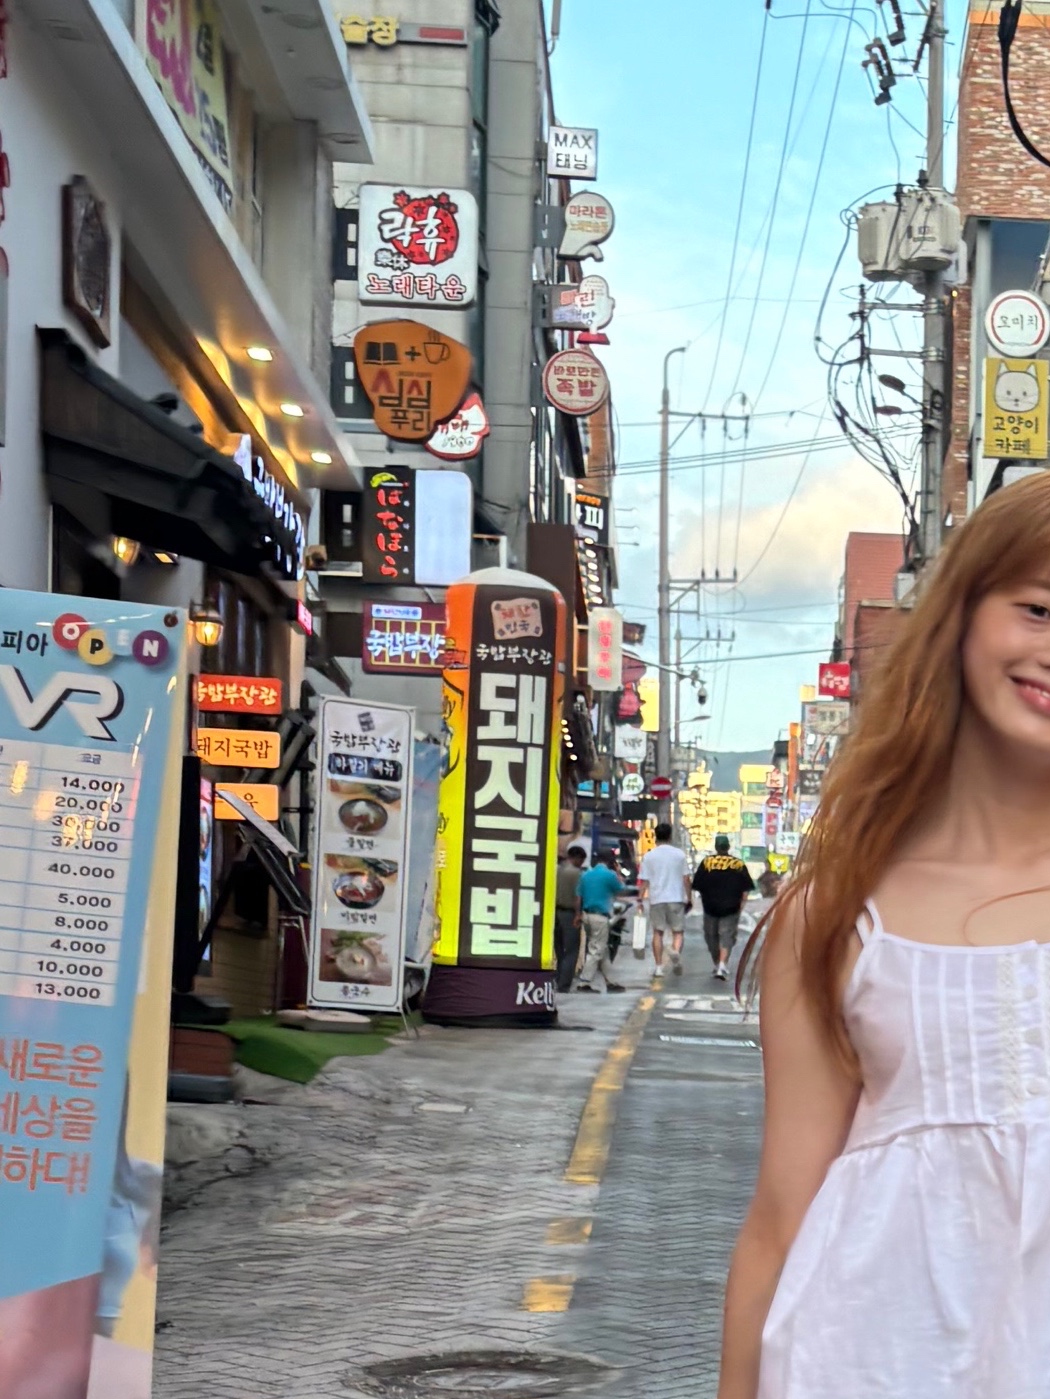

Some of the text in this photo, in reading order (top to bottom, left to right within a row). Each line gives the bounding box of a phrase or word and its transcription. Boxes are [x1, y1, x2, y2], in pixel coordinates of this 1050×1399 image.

[554, 133, 594, 150] MAX
[555, 152, 588, 171] 태닝
[378, 204, 447, 263] 락휴
[365, 272, 467, 301] 노래타운
[370, 367, 432, 408] 심심
[556, 378, 597, 398] 족발
[390, 408, 431, 433] 푸리
[993, 414, 1039, 436] 고양이
[995, 437, 1031, 456] 카페
[475, 643, 552, 665] 국밥부장관
[0, 663, 125, 743] VR
[61, 776, 125, 794] 14.000
[54, 796, 123, 814] 20.000
[468, 671, 548, 959] 돼지국밥
[47, 862, 116, 880] 40.000
[57, 892, 112, 909] 5.000
[54, 915, 109, 932] 8.000
[50, 938, 106, 955] 4.000
[36, 960, 103, 978] 10.000
[34, 983, 101, 1000] 13.000
